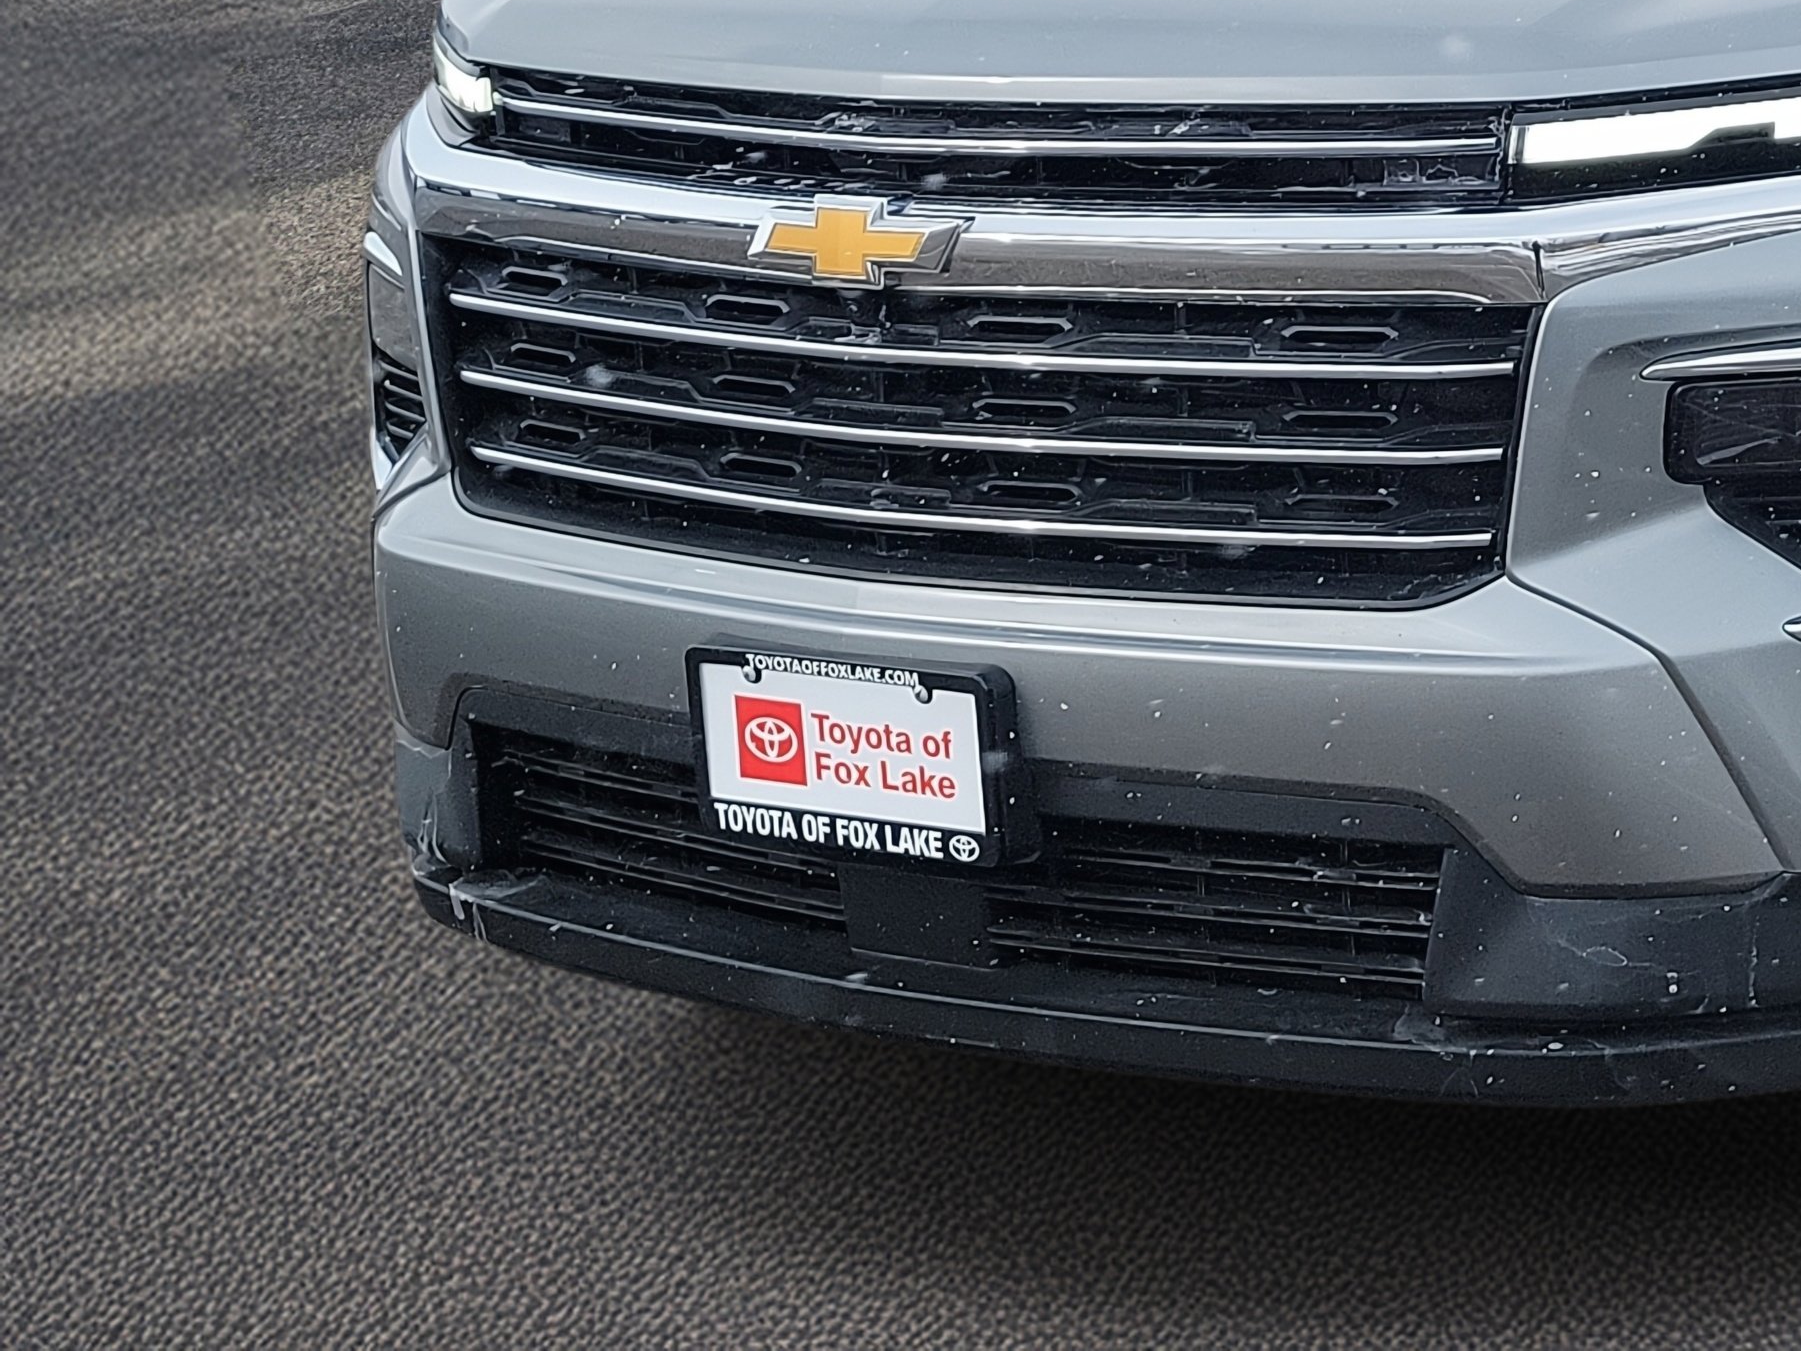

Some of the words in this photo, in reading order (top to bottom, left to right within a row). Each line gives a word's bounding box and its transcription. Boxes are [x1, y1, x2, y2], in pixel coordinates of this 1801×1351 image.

[745, 653, 920, 686] TOYOTAOFFOXLAKE.COM
[810, 712, 913, 754] Toyota
[922, 730, 953, 759] of
[814, 750, 871, 787] Fox
[880, 760, 956, 799] Lake
[714, 802, 798, 840] TOYOTA
[801, 814, 832, 845] OF
[836, 817, 881, 850] FOX
[884, 824, 945, 860] LAKE
